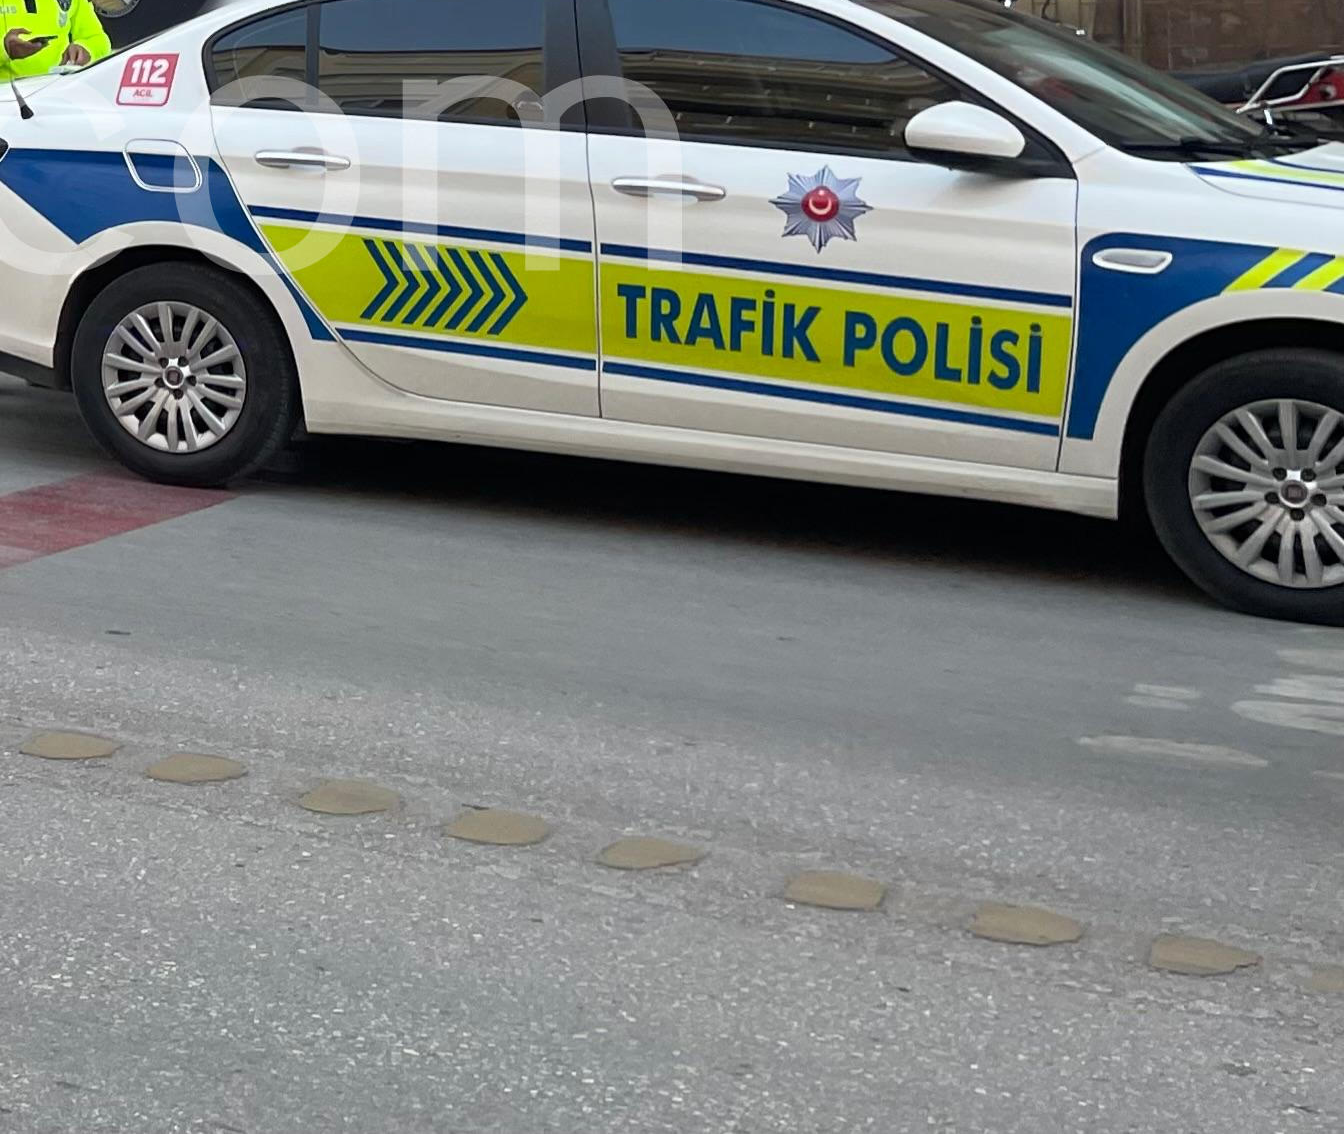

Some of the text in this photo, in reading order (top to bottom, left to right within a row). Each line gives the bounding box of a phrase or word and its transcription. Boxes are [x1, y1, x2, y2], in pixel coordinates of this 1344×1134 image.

[131, 58, 169, 83] 112
[617, 283, 1043, 394] TRAFİK POLİSİ
